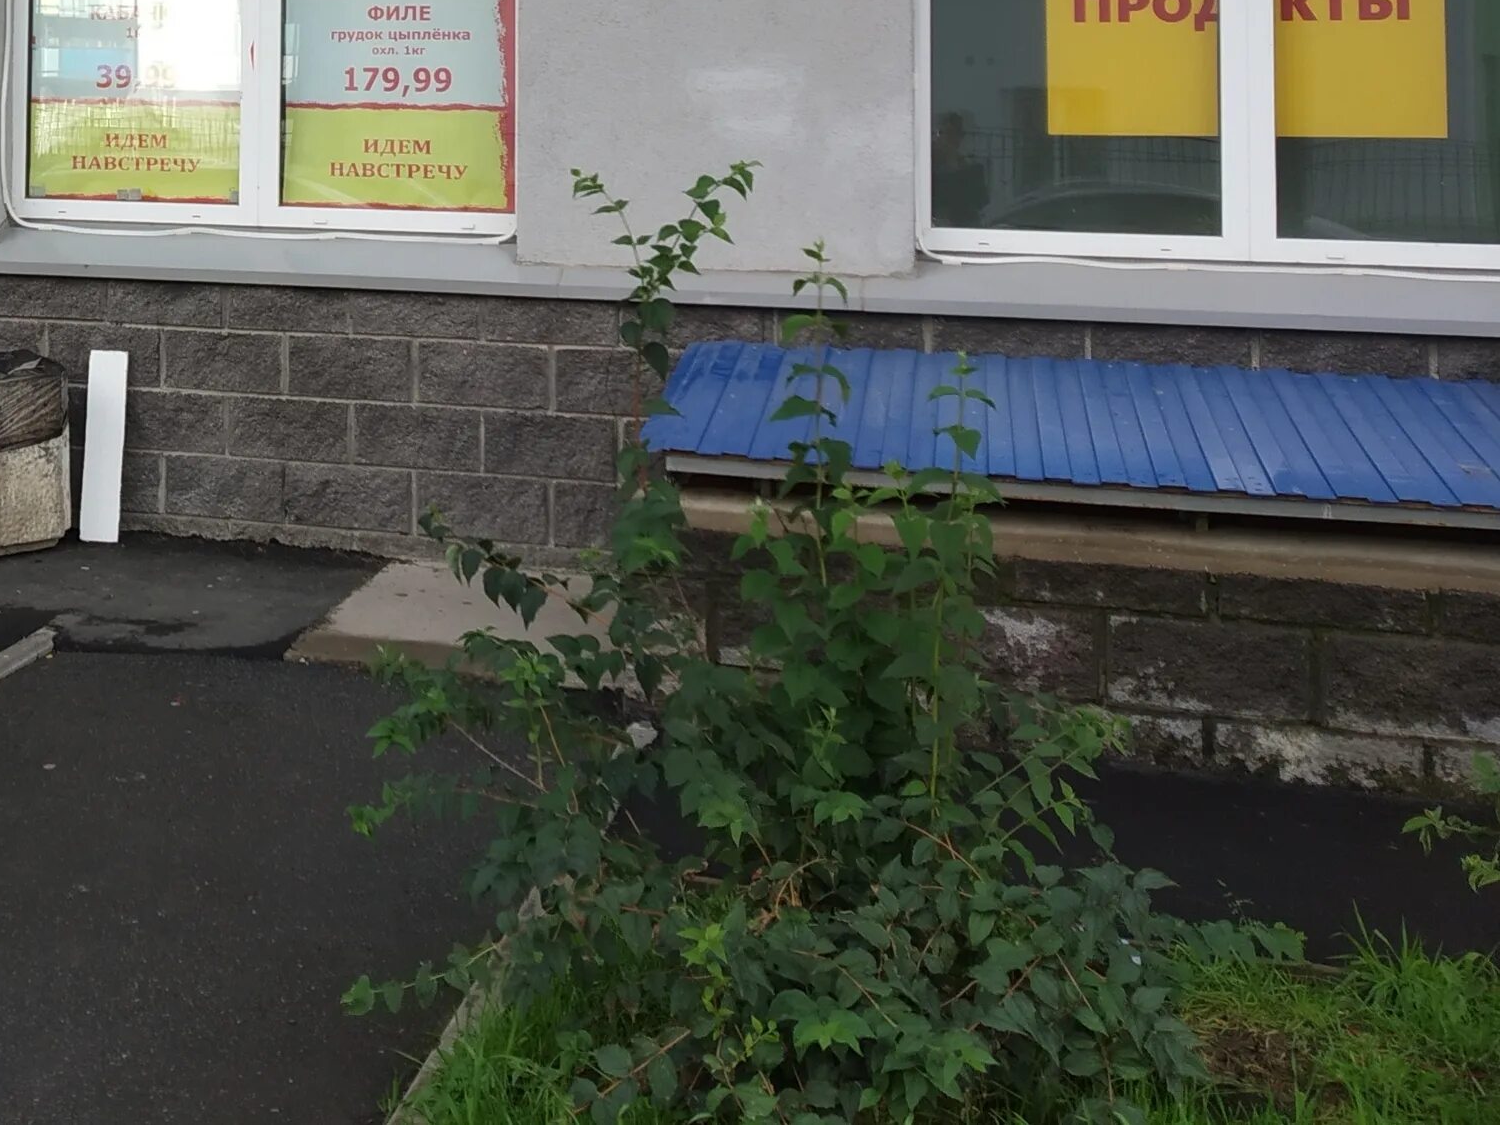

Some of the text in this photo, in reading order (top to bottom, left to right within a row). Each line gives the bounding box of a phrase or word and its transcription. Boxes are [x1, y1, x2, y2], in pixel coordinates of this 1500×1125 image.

[367, 5, 432, 22] ФИЛЕ
[331, 28, 471, 42] грудок цыплёнка
[372, 46, 426, 56] охл. 1кг
[344, 67, 453, 97] 179,99
[105, 133, 168, 151] ИДЕМ
[363, 138, 432, 157] ИДЕМ
[71, 155, 201, 173] НАВСТРЕЧУ
[329, 161, 469, 181] НАВСТРЕЧУ
